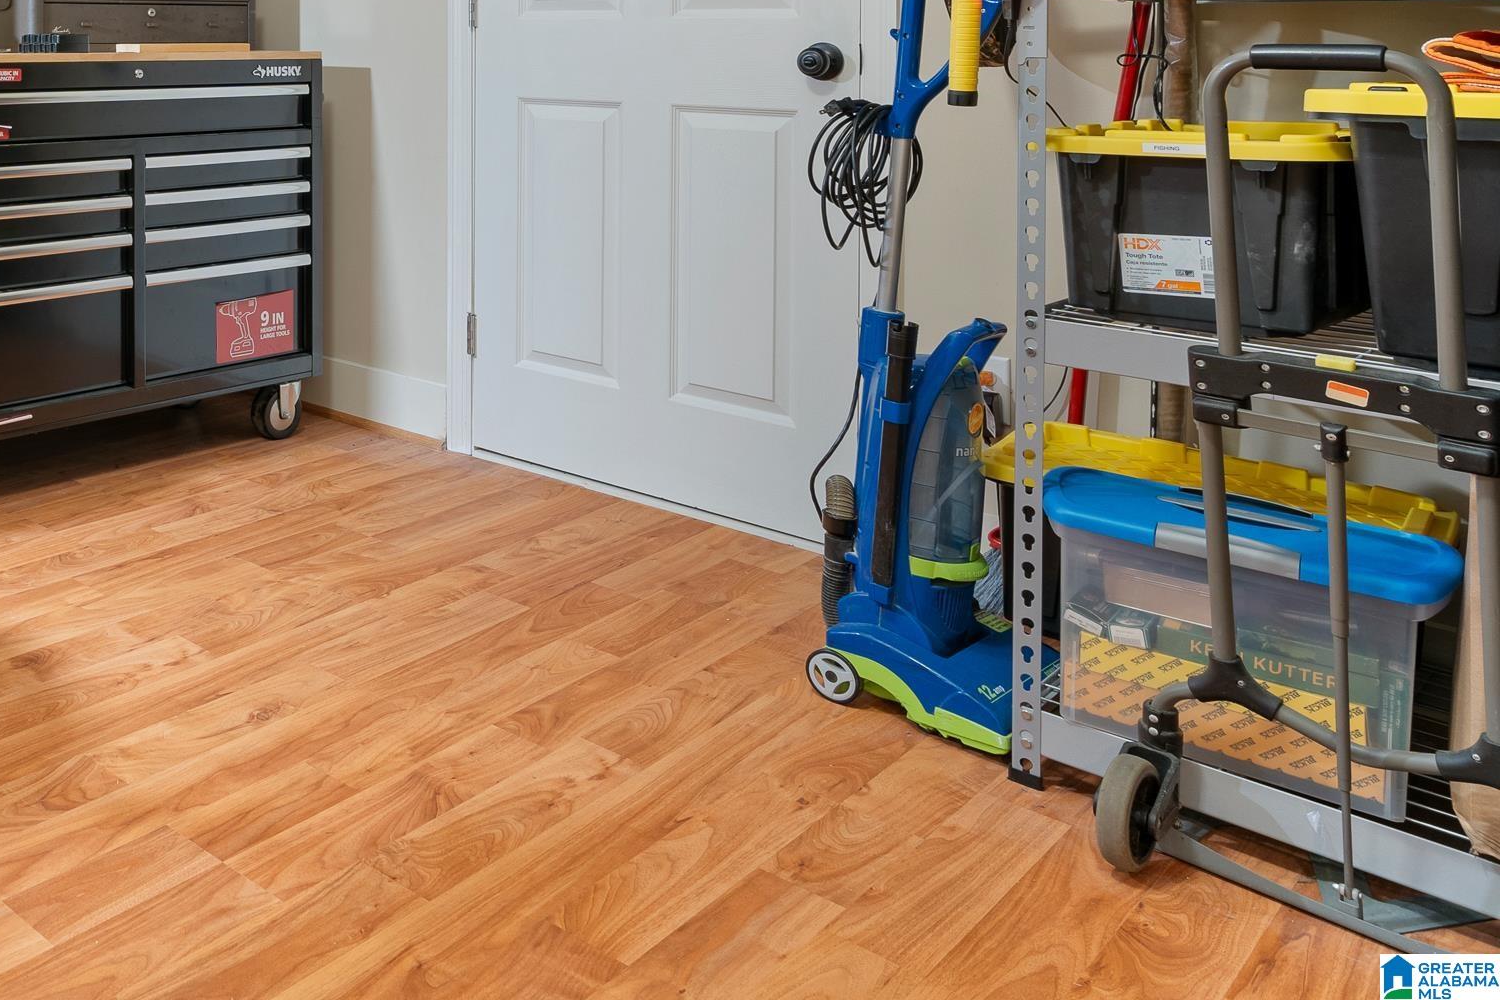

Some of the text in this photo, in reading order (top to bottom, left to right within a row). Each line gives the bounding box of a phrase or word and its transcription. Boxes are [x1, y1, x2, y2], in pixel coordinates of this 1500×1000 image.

[266, 66, 301, 76] HUSKY
[1123, 237, 1162, 251] HDX
[1161, 280, 1166, 288] 7
[260, 311, 284, 327] 9 IN
